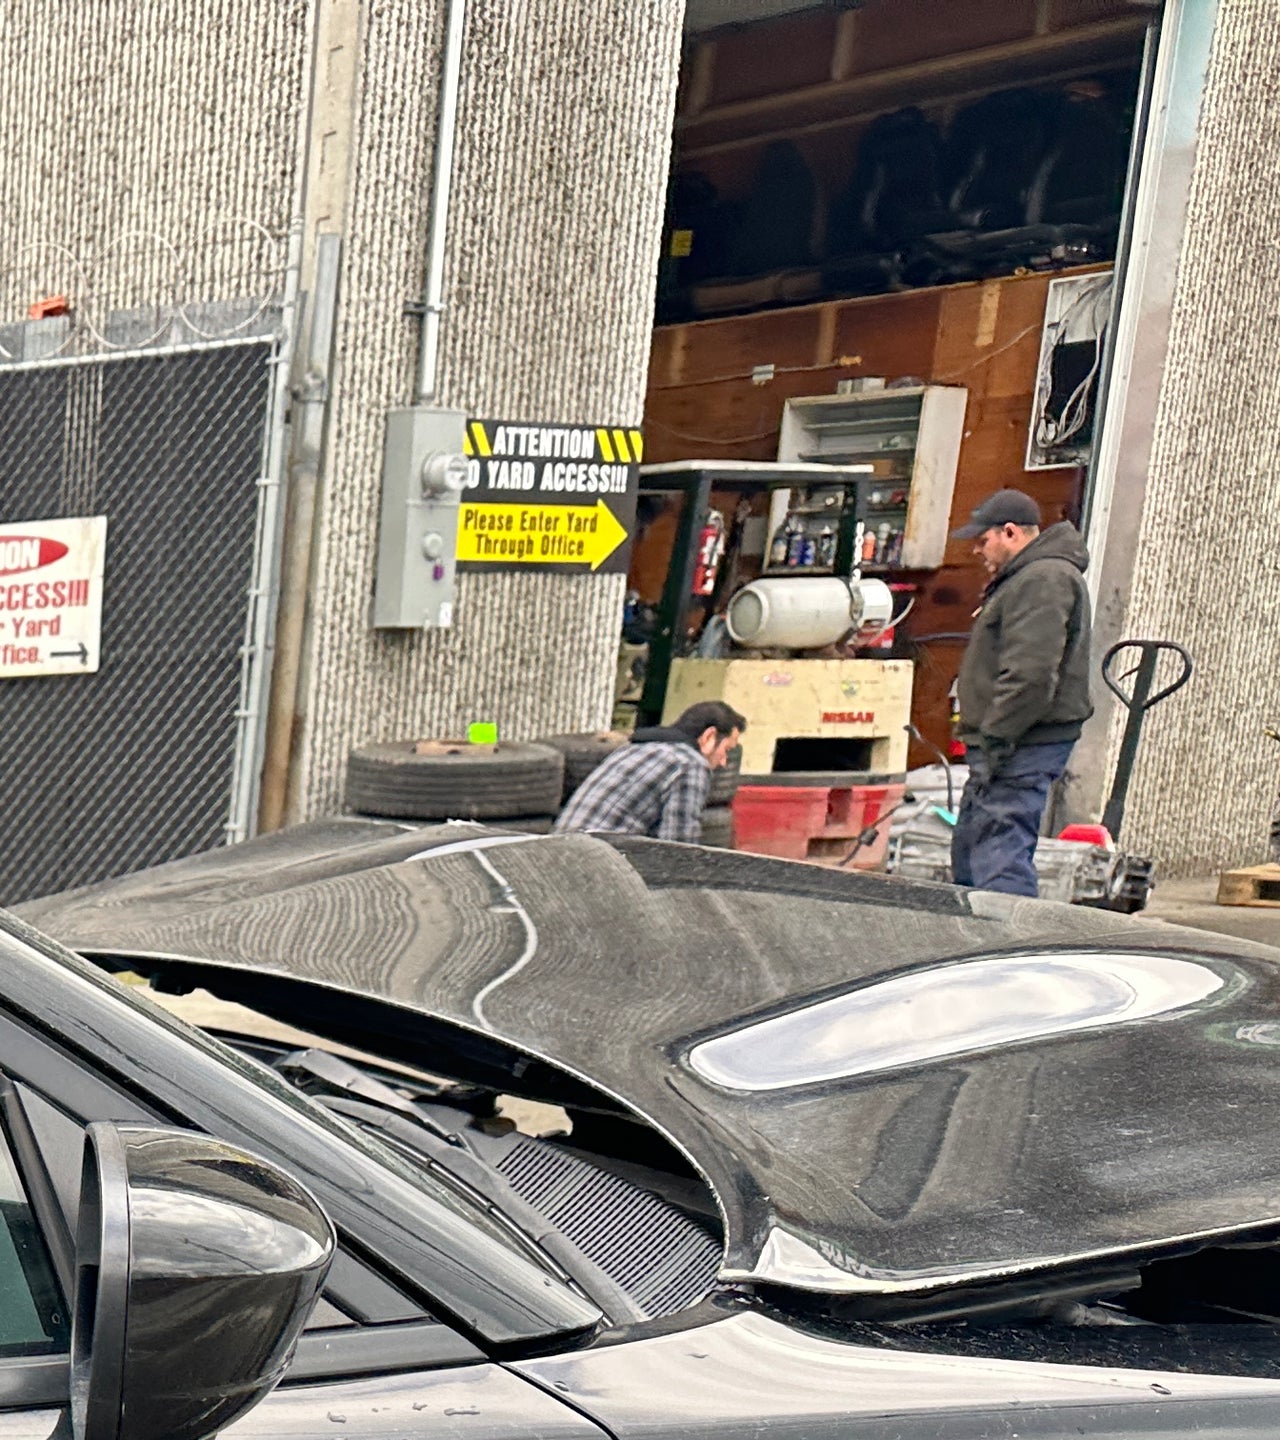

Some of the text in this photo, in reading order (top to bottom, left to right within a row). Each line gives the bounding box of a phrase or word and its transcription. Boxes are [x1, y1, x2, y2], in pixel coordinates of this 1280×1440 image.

[493, 425, 595, 459] ATTENTION
[487, 460, 535, 490] YARD
[540, 463, 628, 493] ACCESS!!!
[463, 509, 598, 533] Please Enter Yard
[475, 534, 585, 558] Through Office
[12, 615, 61, 638] Yard
[822, 711, 875, 724] NISSAN
